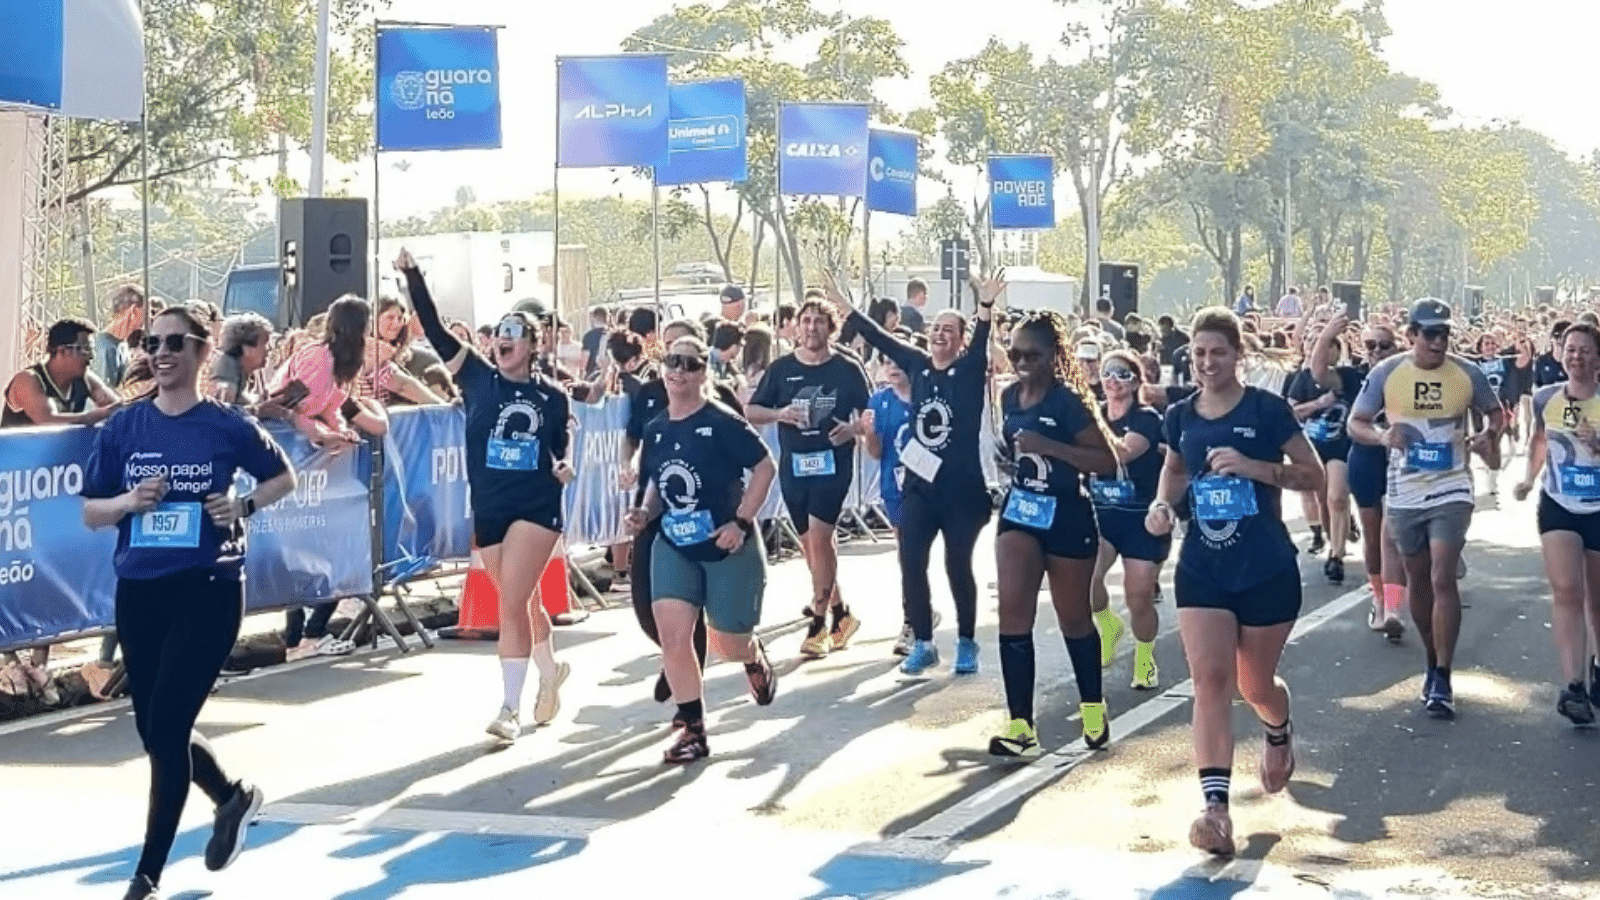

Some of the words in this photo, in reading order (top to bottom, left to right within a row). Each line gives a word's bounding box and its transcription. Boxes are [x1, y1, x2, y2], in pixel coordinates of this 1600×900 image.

[425, 69, 492, 90] guara
[426, 107, 455, 119] leão
[668, 124, 716, 139] Unimed
[786, 143, 841, 158] CAIXA
[993, 180, 1046, 194] POWER
[1018, 194, 1047, 207] ADE
[1413, 402, 1443, 411] team
[125, 462, 168, 477] Nosso
[170, 461, 212, 482] papel
[431, 446, 468, 484] PO
[151, 513, 179, 533] 1957
[0, 559, 33, 585] eão
